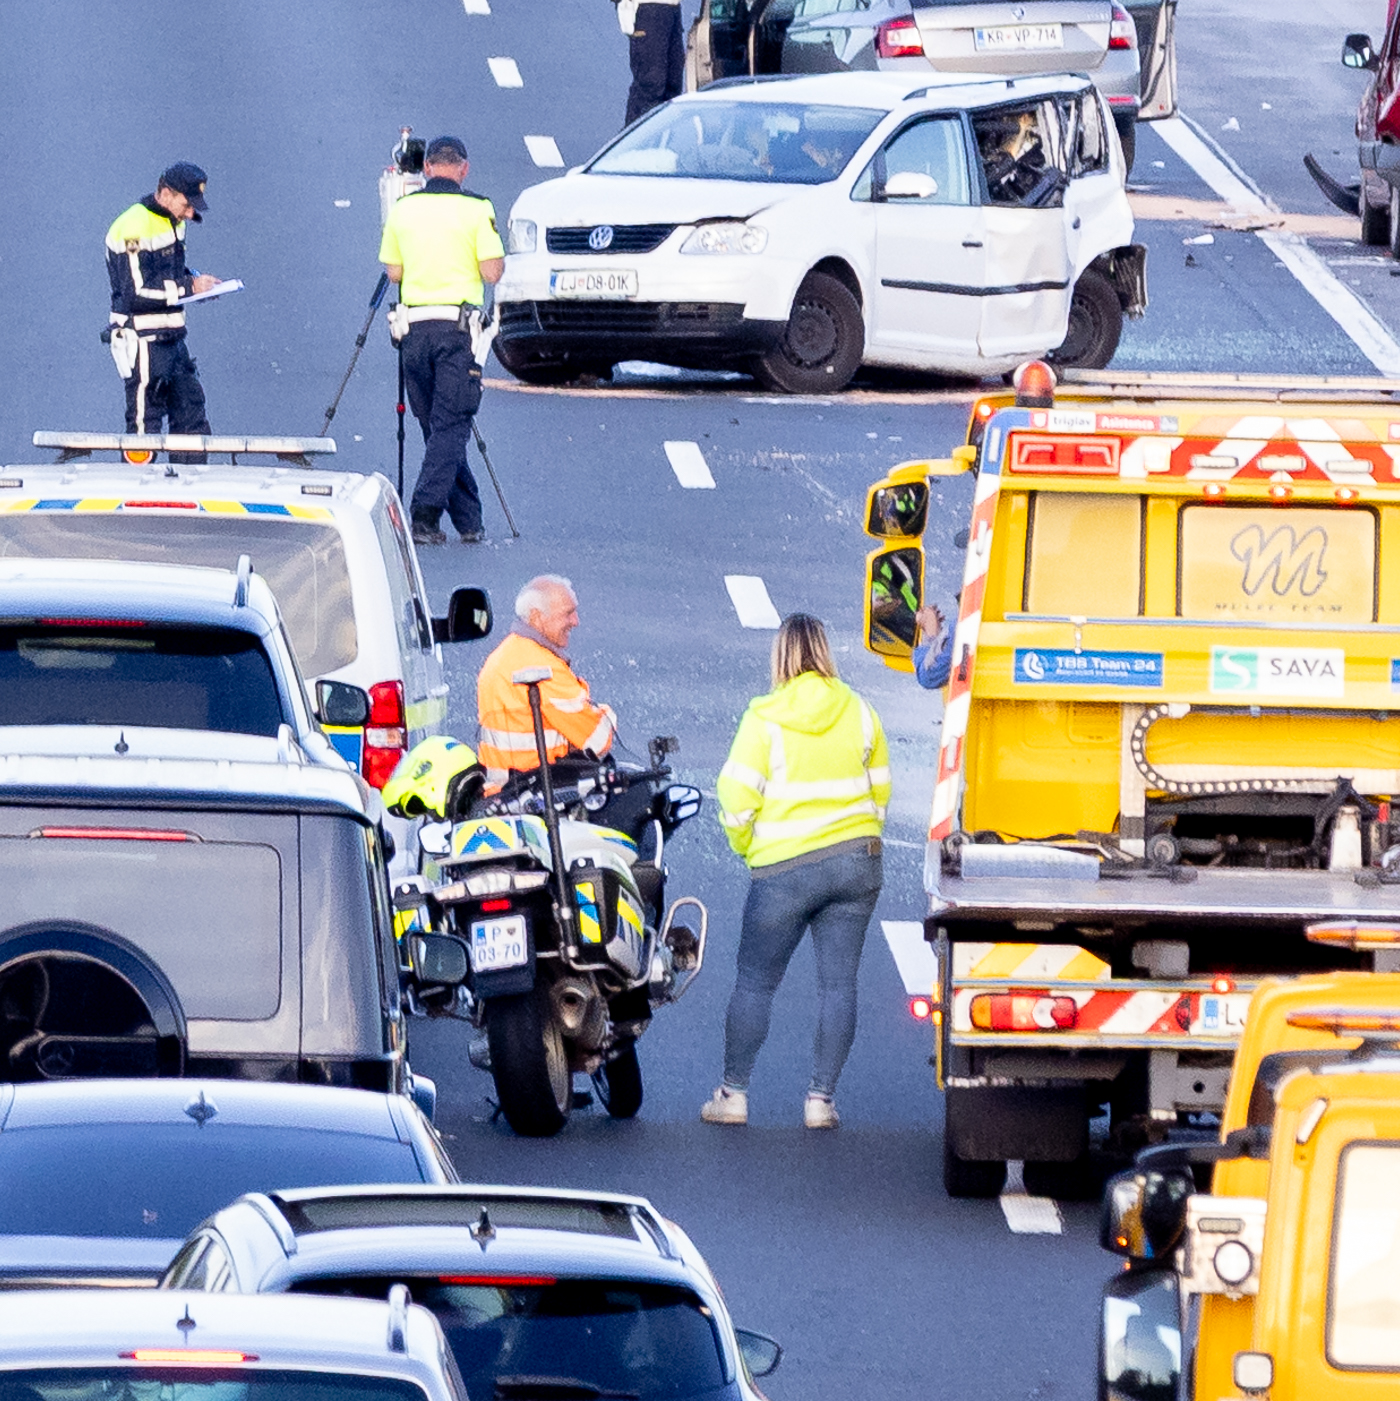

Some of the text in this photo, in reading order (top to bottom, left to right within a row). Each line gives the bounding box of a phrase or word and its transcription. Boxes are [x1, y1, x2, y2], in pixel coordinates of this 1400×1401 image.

[986, 27, 1004, 42] KR
[560, 274, 577, 291] LJ
[1091, 656, 1131, 671] Team
[1270, 657, 1337, 678] SAVA
